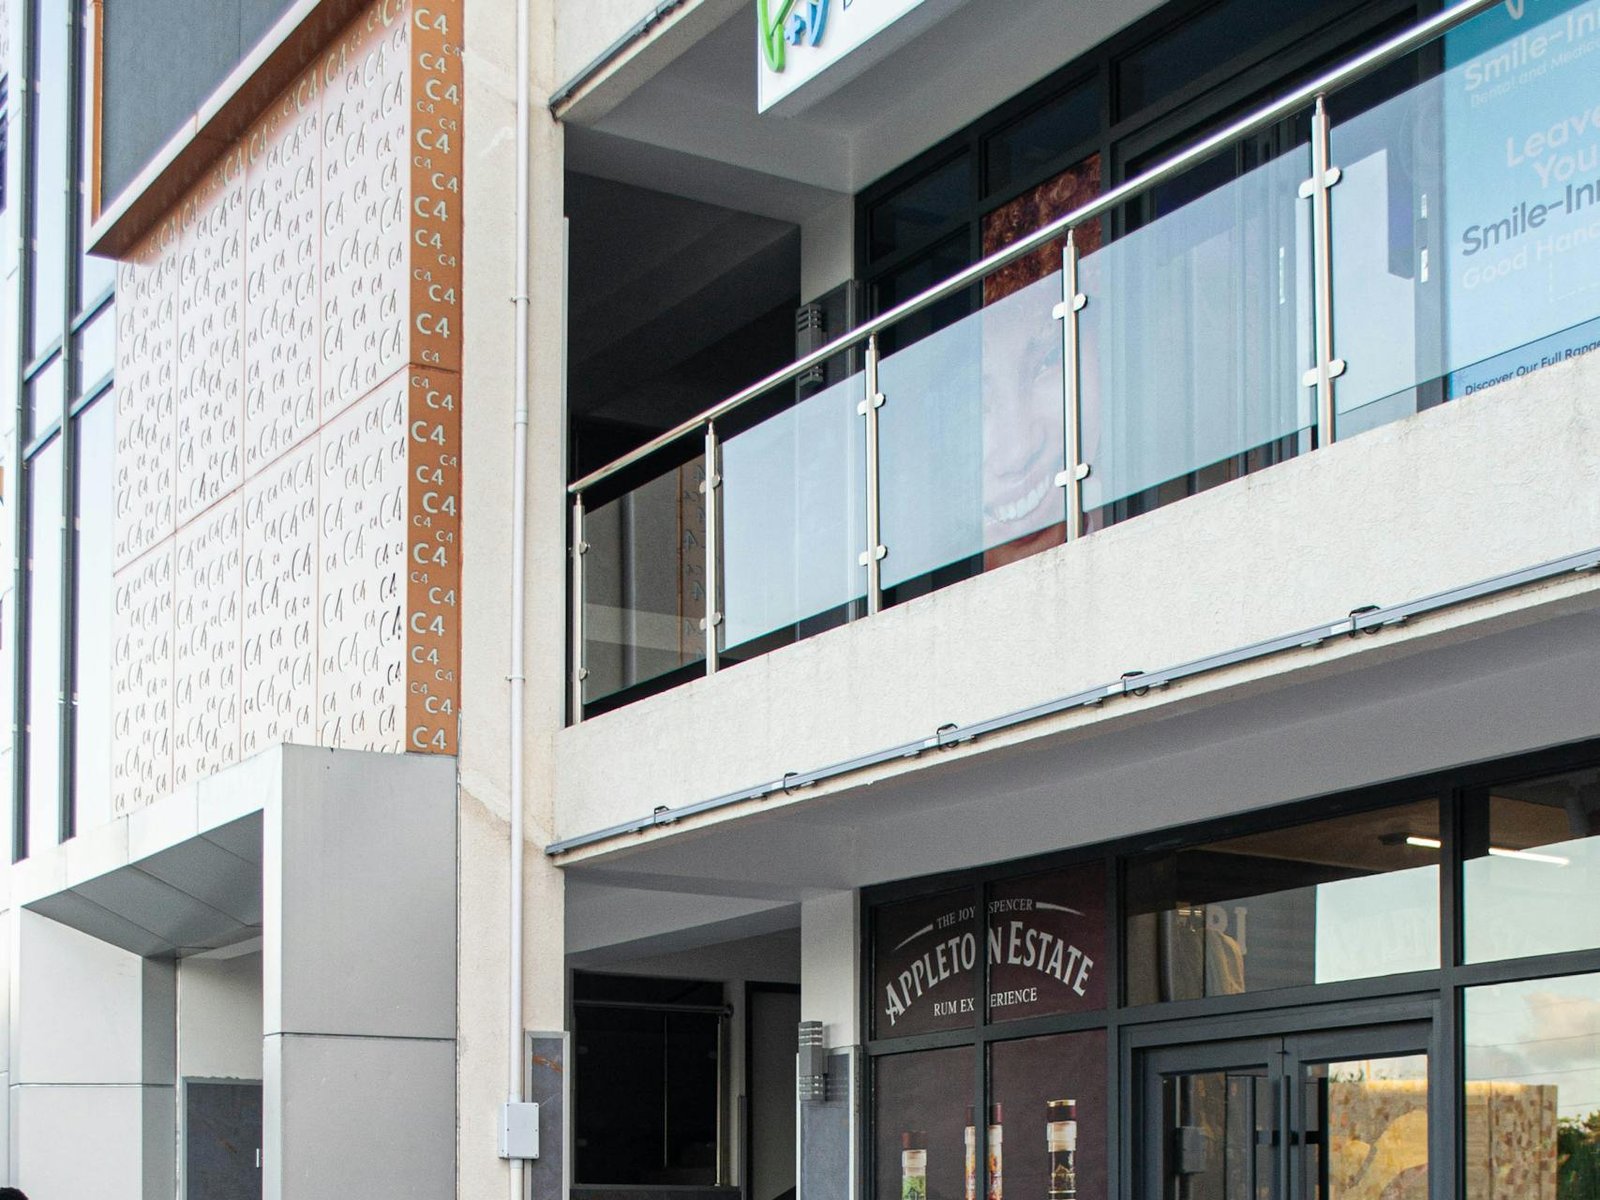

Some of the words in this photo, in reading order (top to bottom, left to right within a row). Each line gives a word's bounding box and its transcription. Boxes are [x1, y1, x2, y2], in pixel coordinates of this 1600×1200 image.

[415, 9, 448, 35] C4
[443, 44, 461, 56] C4
[1463, 8, 1600, 92] Smile-In
[419, 53, 447, 73] C4
[426, 79, 459, 105] C4
[417, 102, 434, 114] C4
[439, 118, 456, 131] C4
[416, 128, 449, 153] C4
[414, 155, 432, 169] C4
[431, 173, 458, 193] C4
[414, 196, 448, 221] C4
[415, 230, 442, 249] C4
[438, 254, 456, 267] C4
[1463, 246, 1528, 290] Good
[414, 269, 432, 281] C4
[429, 284, 456, 304] C4
[416, 313, 450, 338] C4
[422, 350, 439, 362] C4
[412, 376, 429, 389] C4
[1465, 371, 1513, 396] Discover
[1516, 361, 1538, 377] Our
[1541, 350, 1562, 369] Full
[426, 391, 454, 411] C4
[411, 421, 445, 445] C4
[440, 455, 457, 466] C4
[416, 465, 444, 486] C4
[423, 492, 456, 516] C4
[413, 515, 431, 527] C4
[436, 531, 453, 543] C4
[413, 543, 447, 567] C4
[411, 572, 428, 584] C4
[429, 587, 456, 606] C4
[411, 612, 445, 636] C4
[412, 646, 439, 665] C4
[435, 669, 453, 681] C4
[411, 683, 428, 694] C4
[425, 696, 452, 715] C4
[412, 726, 447, 750] C4
[937, 912, 956, 929] THE
[958, 905, 976, 922] JOY
[1007, 920, 1094, 998] ESTATE
[934, 1001, 957, 1017] RUM
[960, 987, 1038, 1013] EXERIENCE
